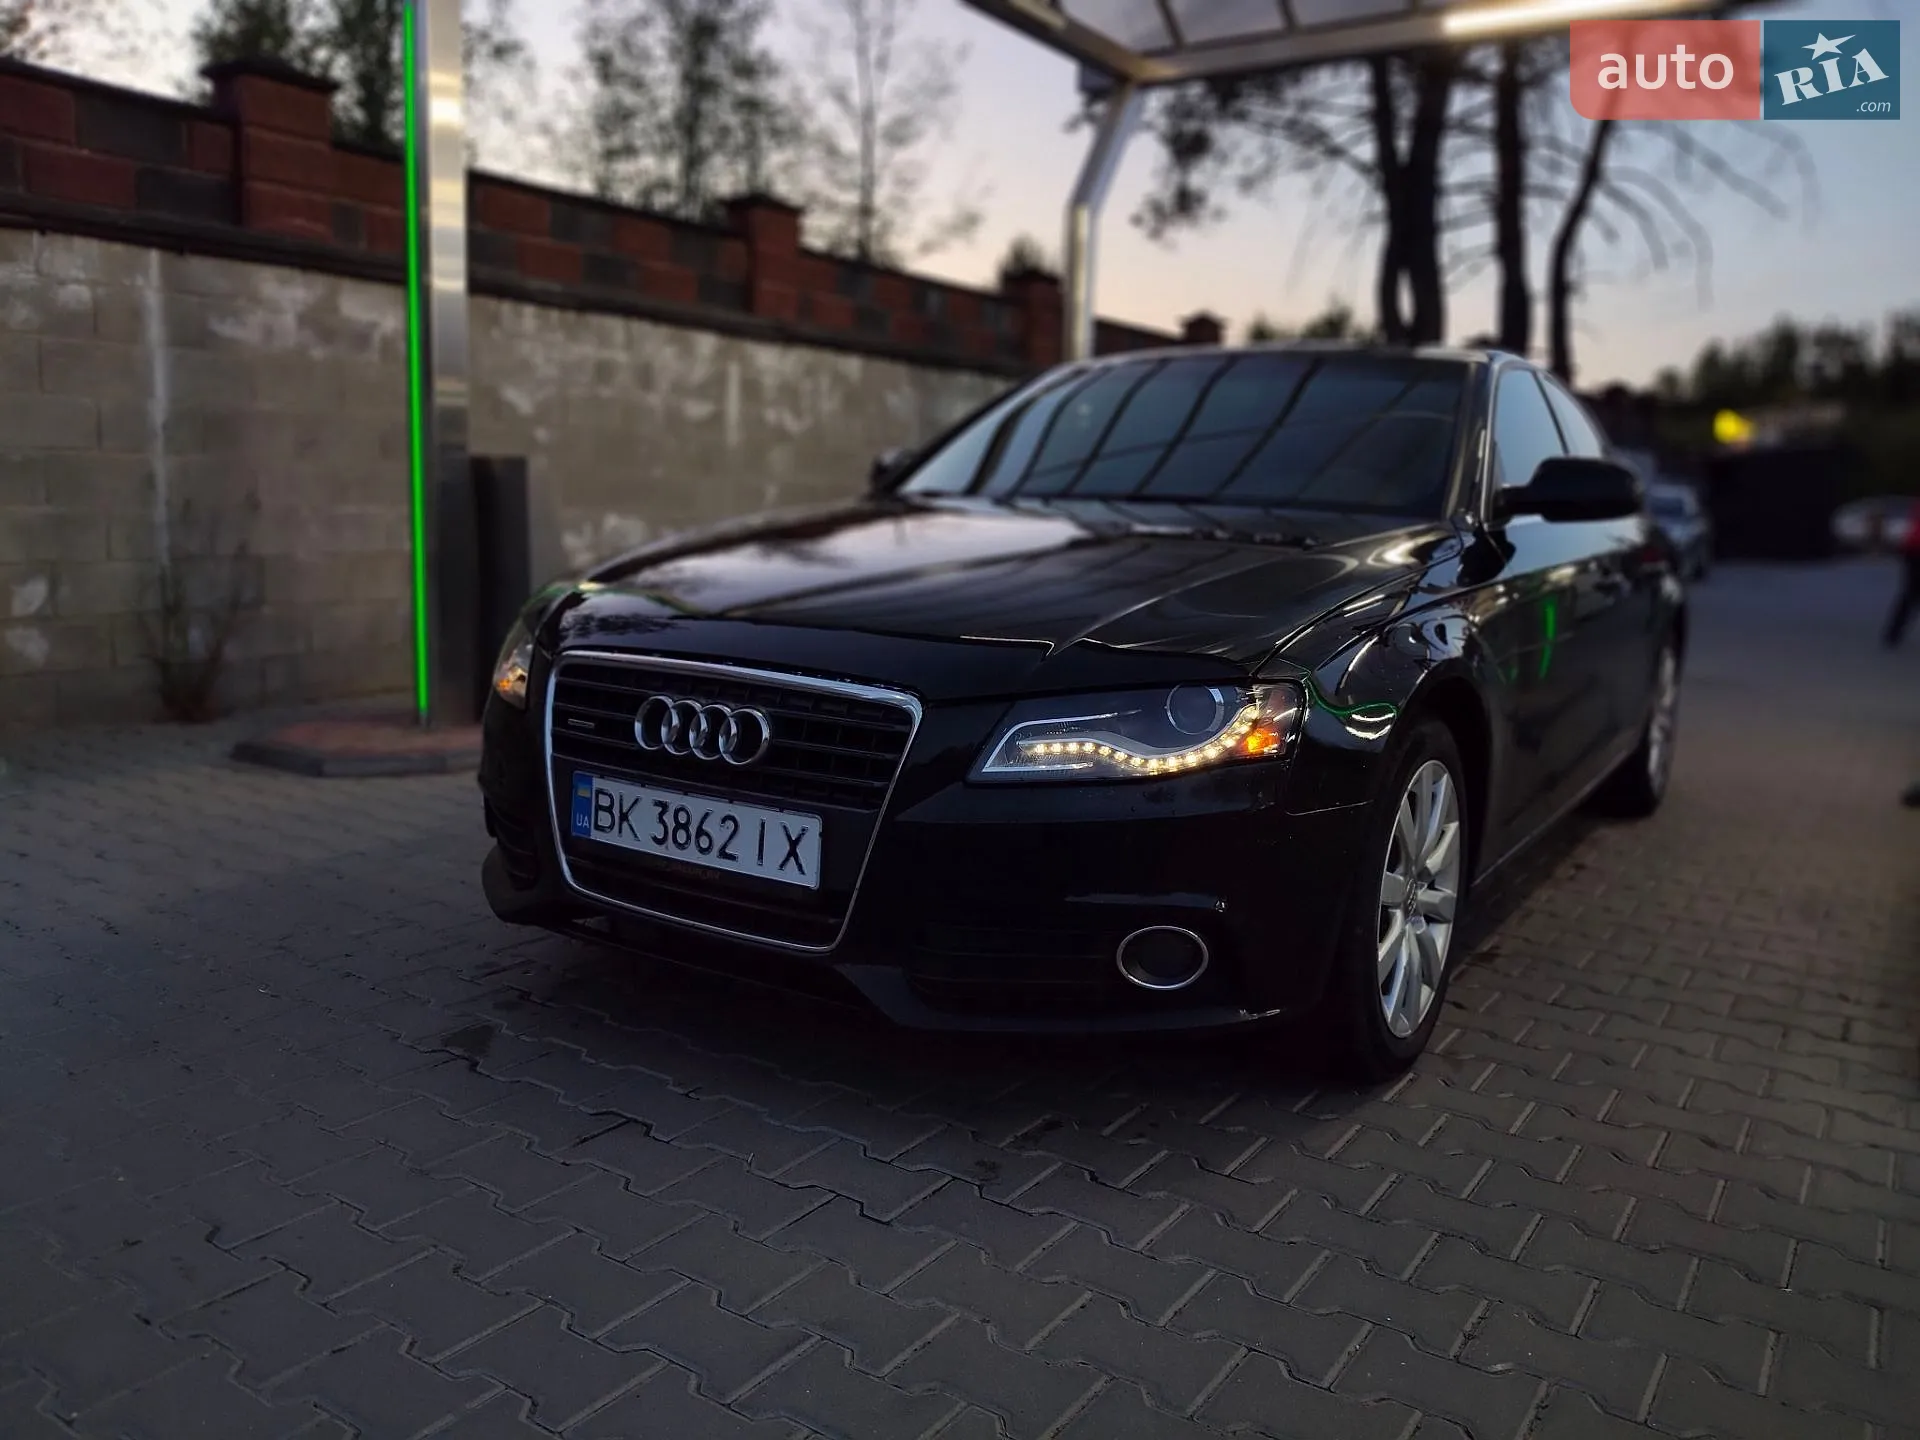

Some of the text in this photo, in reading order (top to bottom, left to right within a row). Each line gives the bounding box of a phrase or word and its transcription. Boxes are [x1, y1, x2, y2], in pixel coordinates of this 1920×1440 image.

[576, 816, 590, 829] UA
[593, 788, 641, 842] BK
[650, 799, 739, 862] 3862
